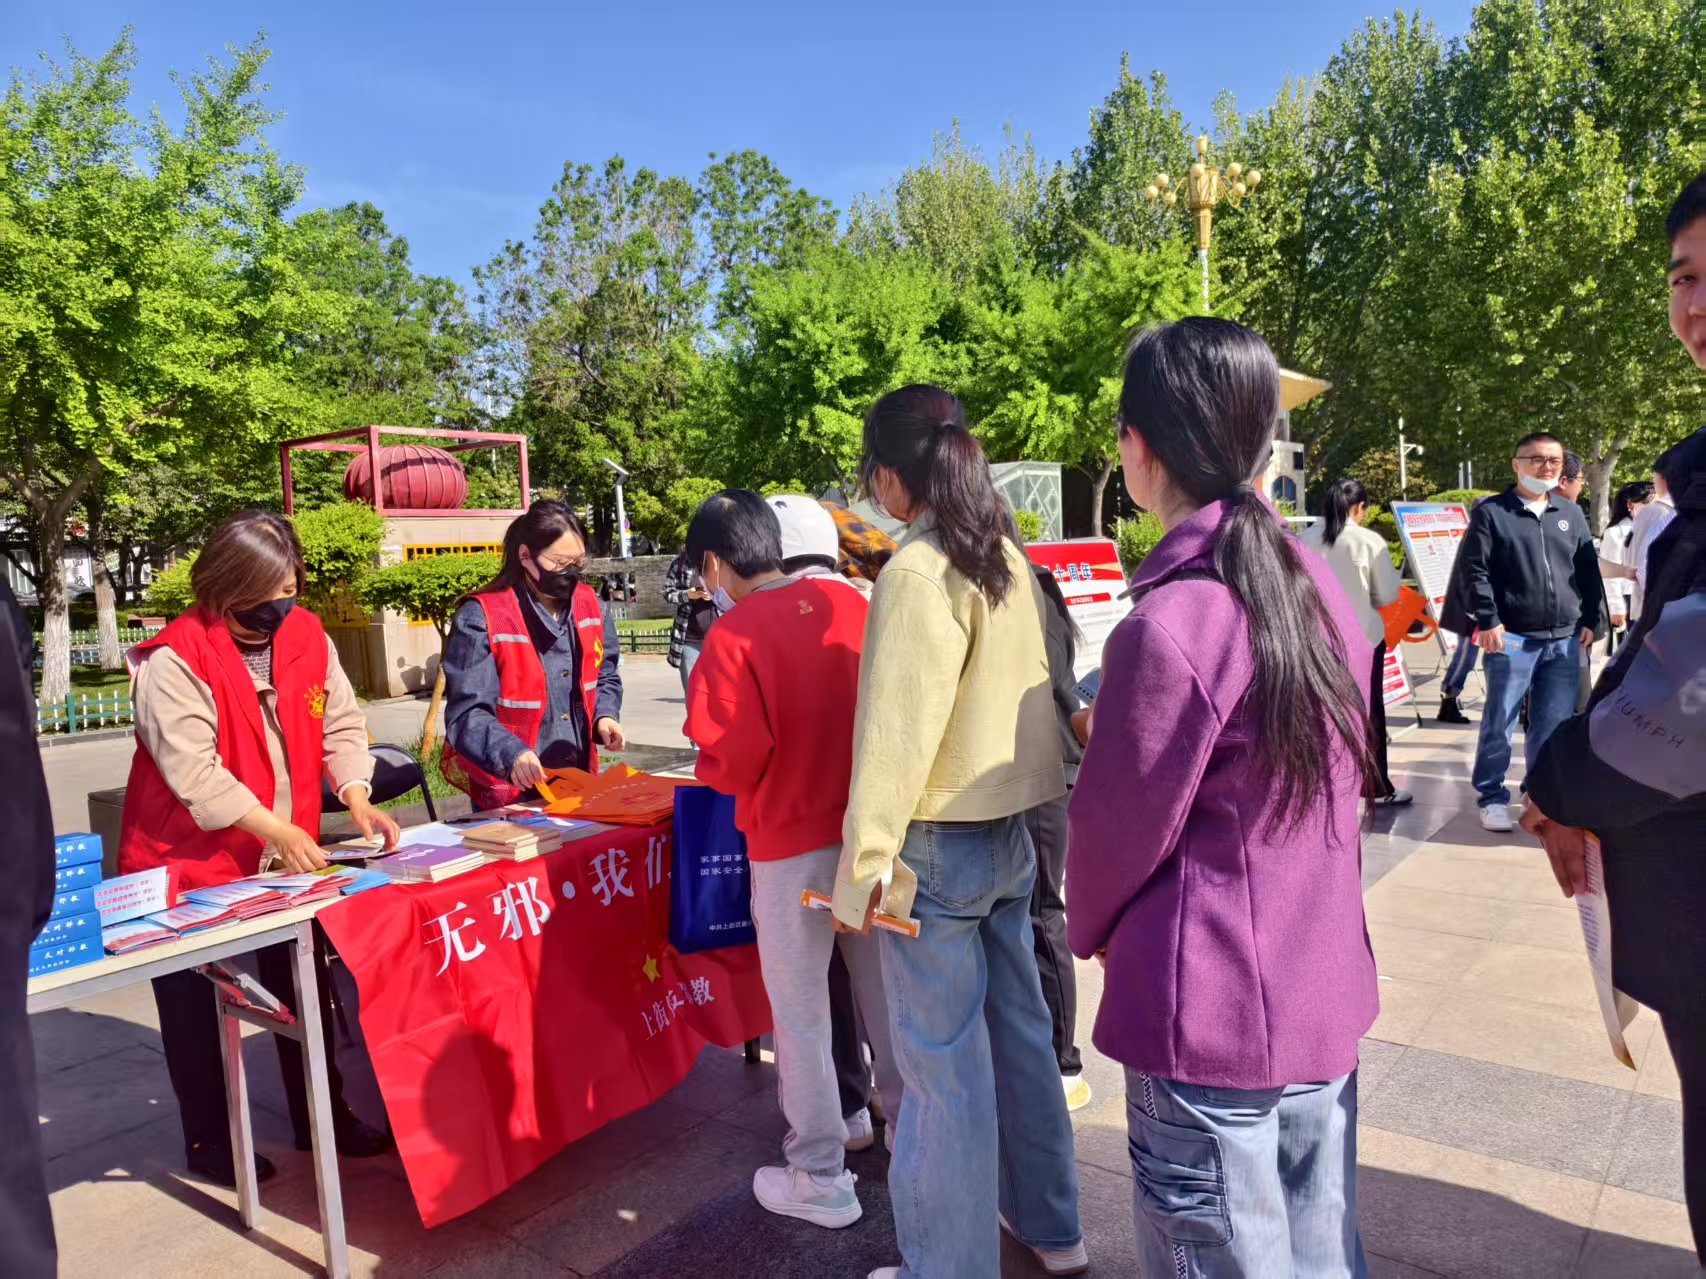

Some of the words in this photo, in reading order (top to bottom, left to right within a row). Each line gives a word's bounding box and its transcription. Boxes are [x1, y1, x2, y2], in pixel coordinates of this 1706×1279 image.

[1042, 561, 1093, 582] 十周年
[44, 943, 89, 960] 反对邪教
